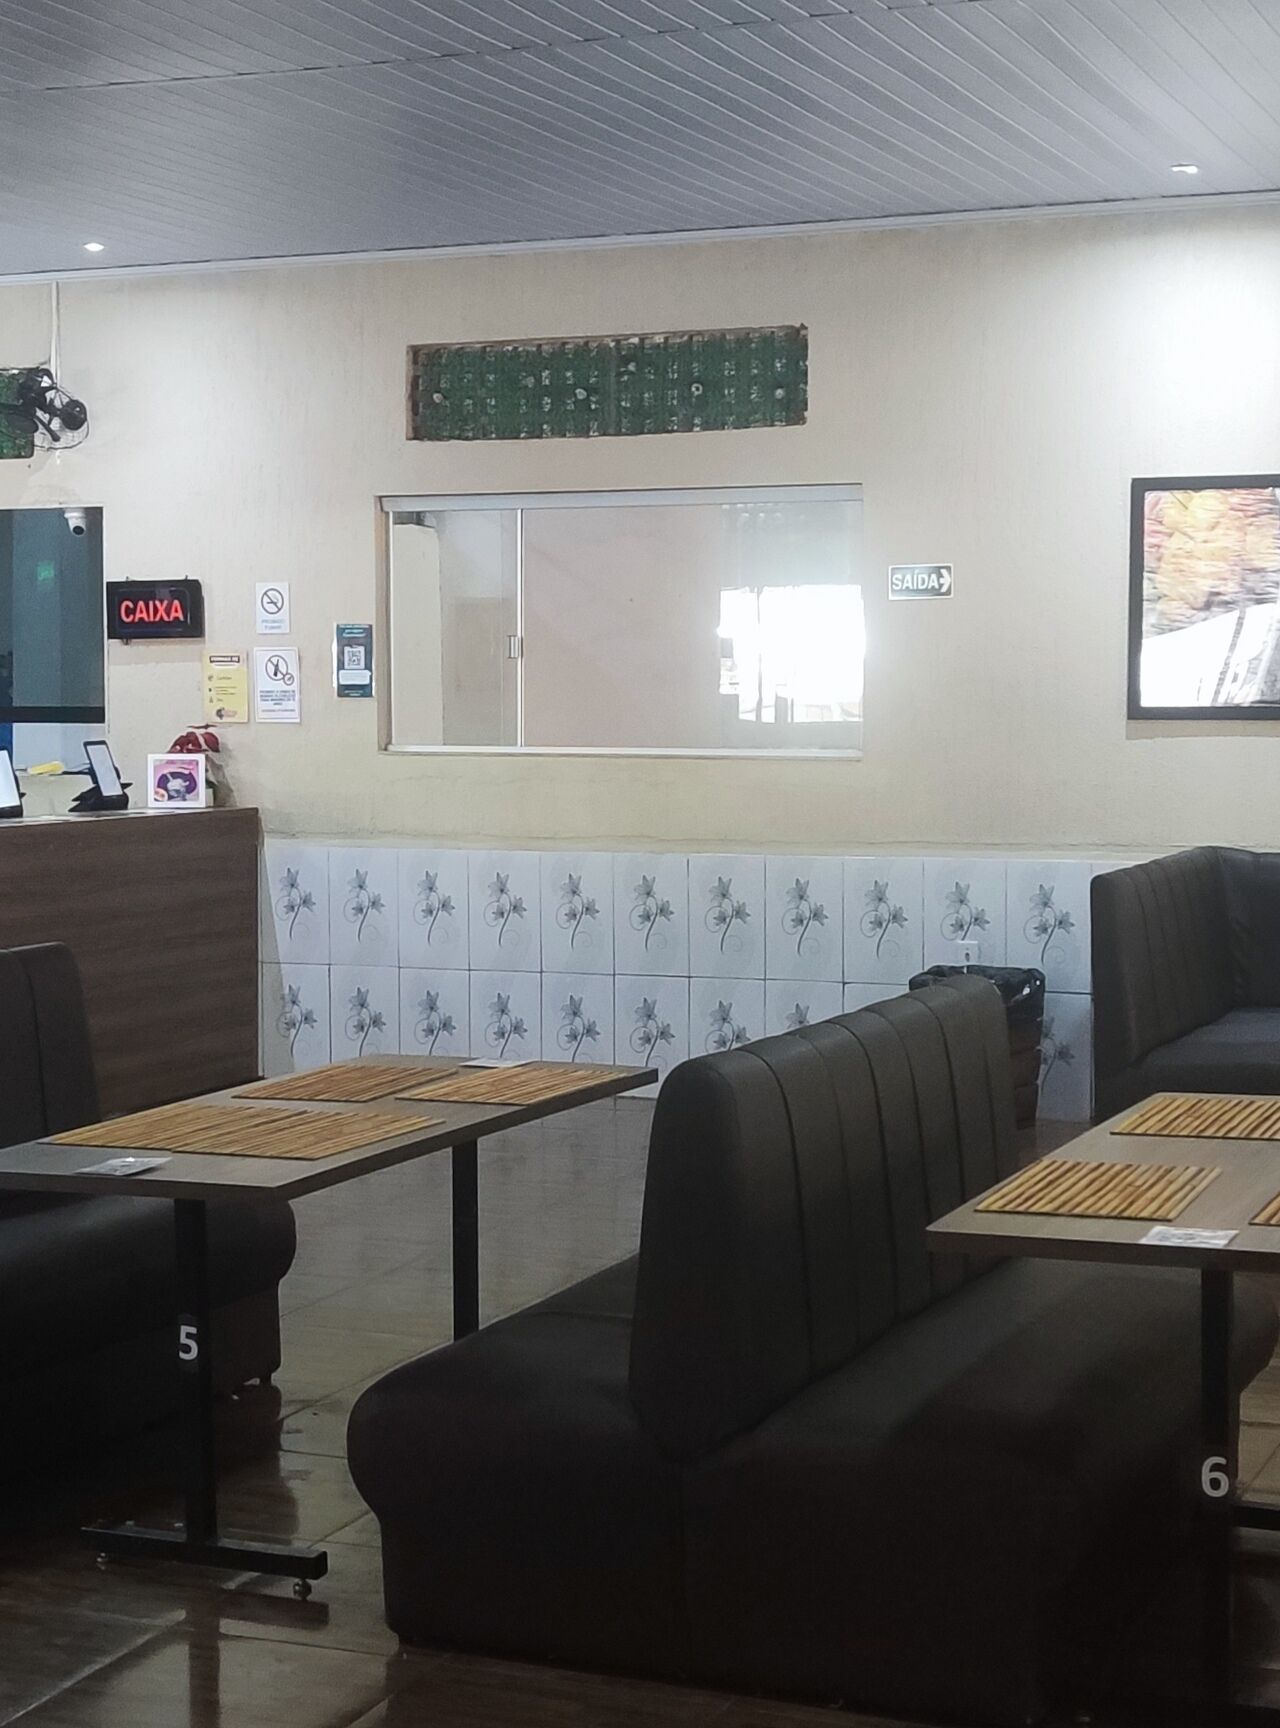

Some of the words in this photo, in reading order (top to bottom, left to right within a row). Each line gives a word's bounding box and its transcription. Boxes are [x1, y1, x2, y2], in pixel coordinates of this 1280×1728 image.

[892, 569, 939, 590] SAÍDA
[120, 599, 184, 623] CAIXA
[178, 1325, 199, 1361] 5
[1201, 1455, 1230, 1498] 6
